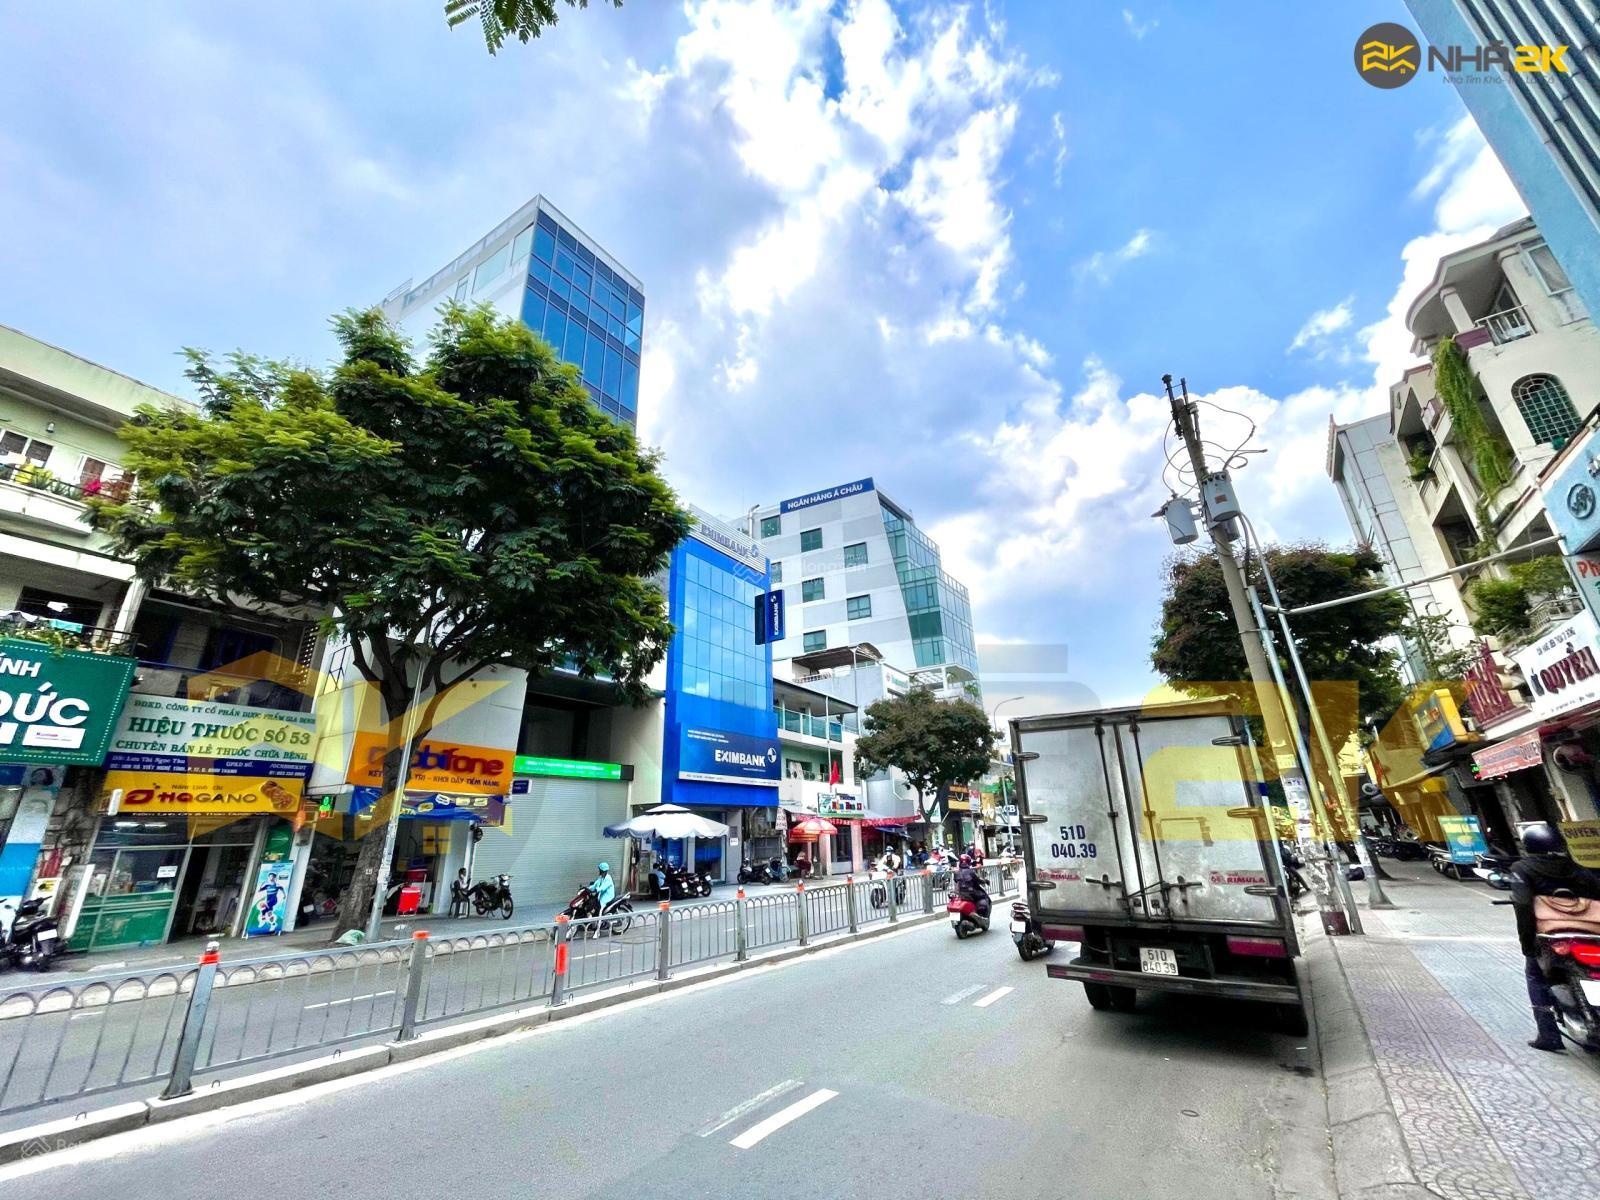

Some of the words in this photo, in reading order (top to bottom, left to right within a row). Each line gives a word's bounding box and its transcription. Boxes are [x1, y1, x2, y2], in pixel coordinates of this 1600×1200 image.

[787, 497, 810, 510] NGÂN
[810, 492, 832, 503] HÀNG
[840, 484, 863, 495] CHÂU
[701, 523, 751, 558] EXIMBANK
[128, 716, 187, 737] HIỆU
[191, 721, 259, 741] THUỐC
[263, 725, 289, 743] SỐ
[289, 731, 311, 745] 53
[116, 740, 167, 752] CHUYÊN
[170, 742, 195, 754] BÁN
[214, 746, 251, 757] THUỐC
[714, 748, 766, 768] EXIMBANK
[1060, 825, 1086, 841] 51D
[1051, 843, 1097, 858] 040.39
